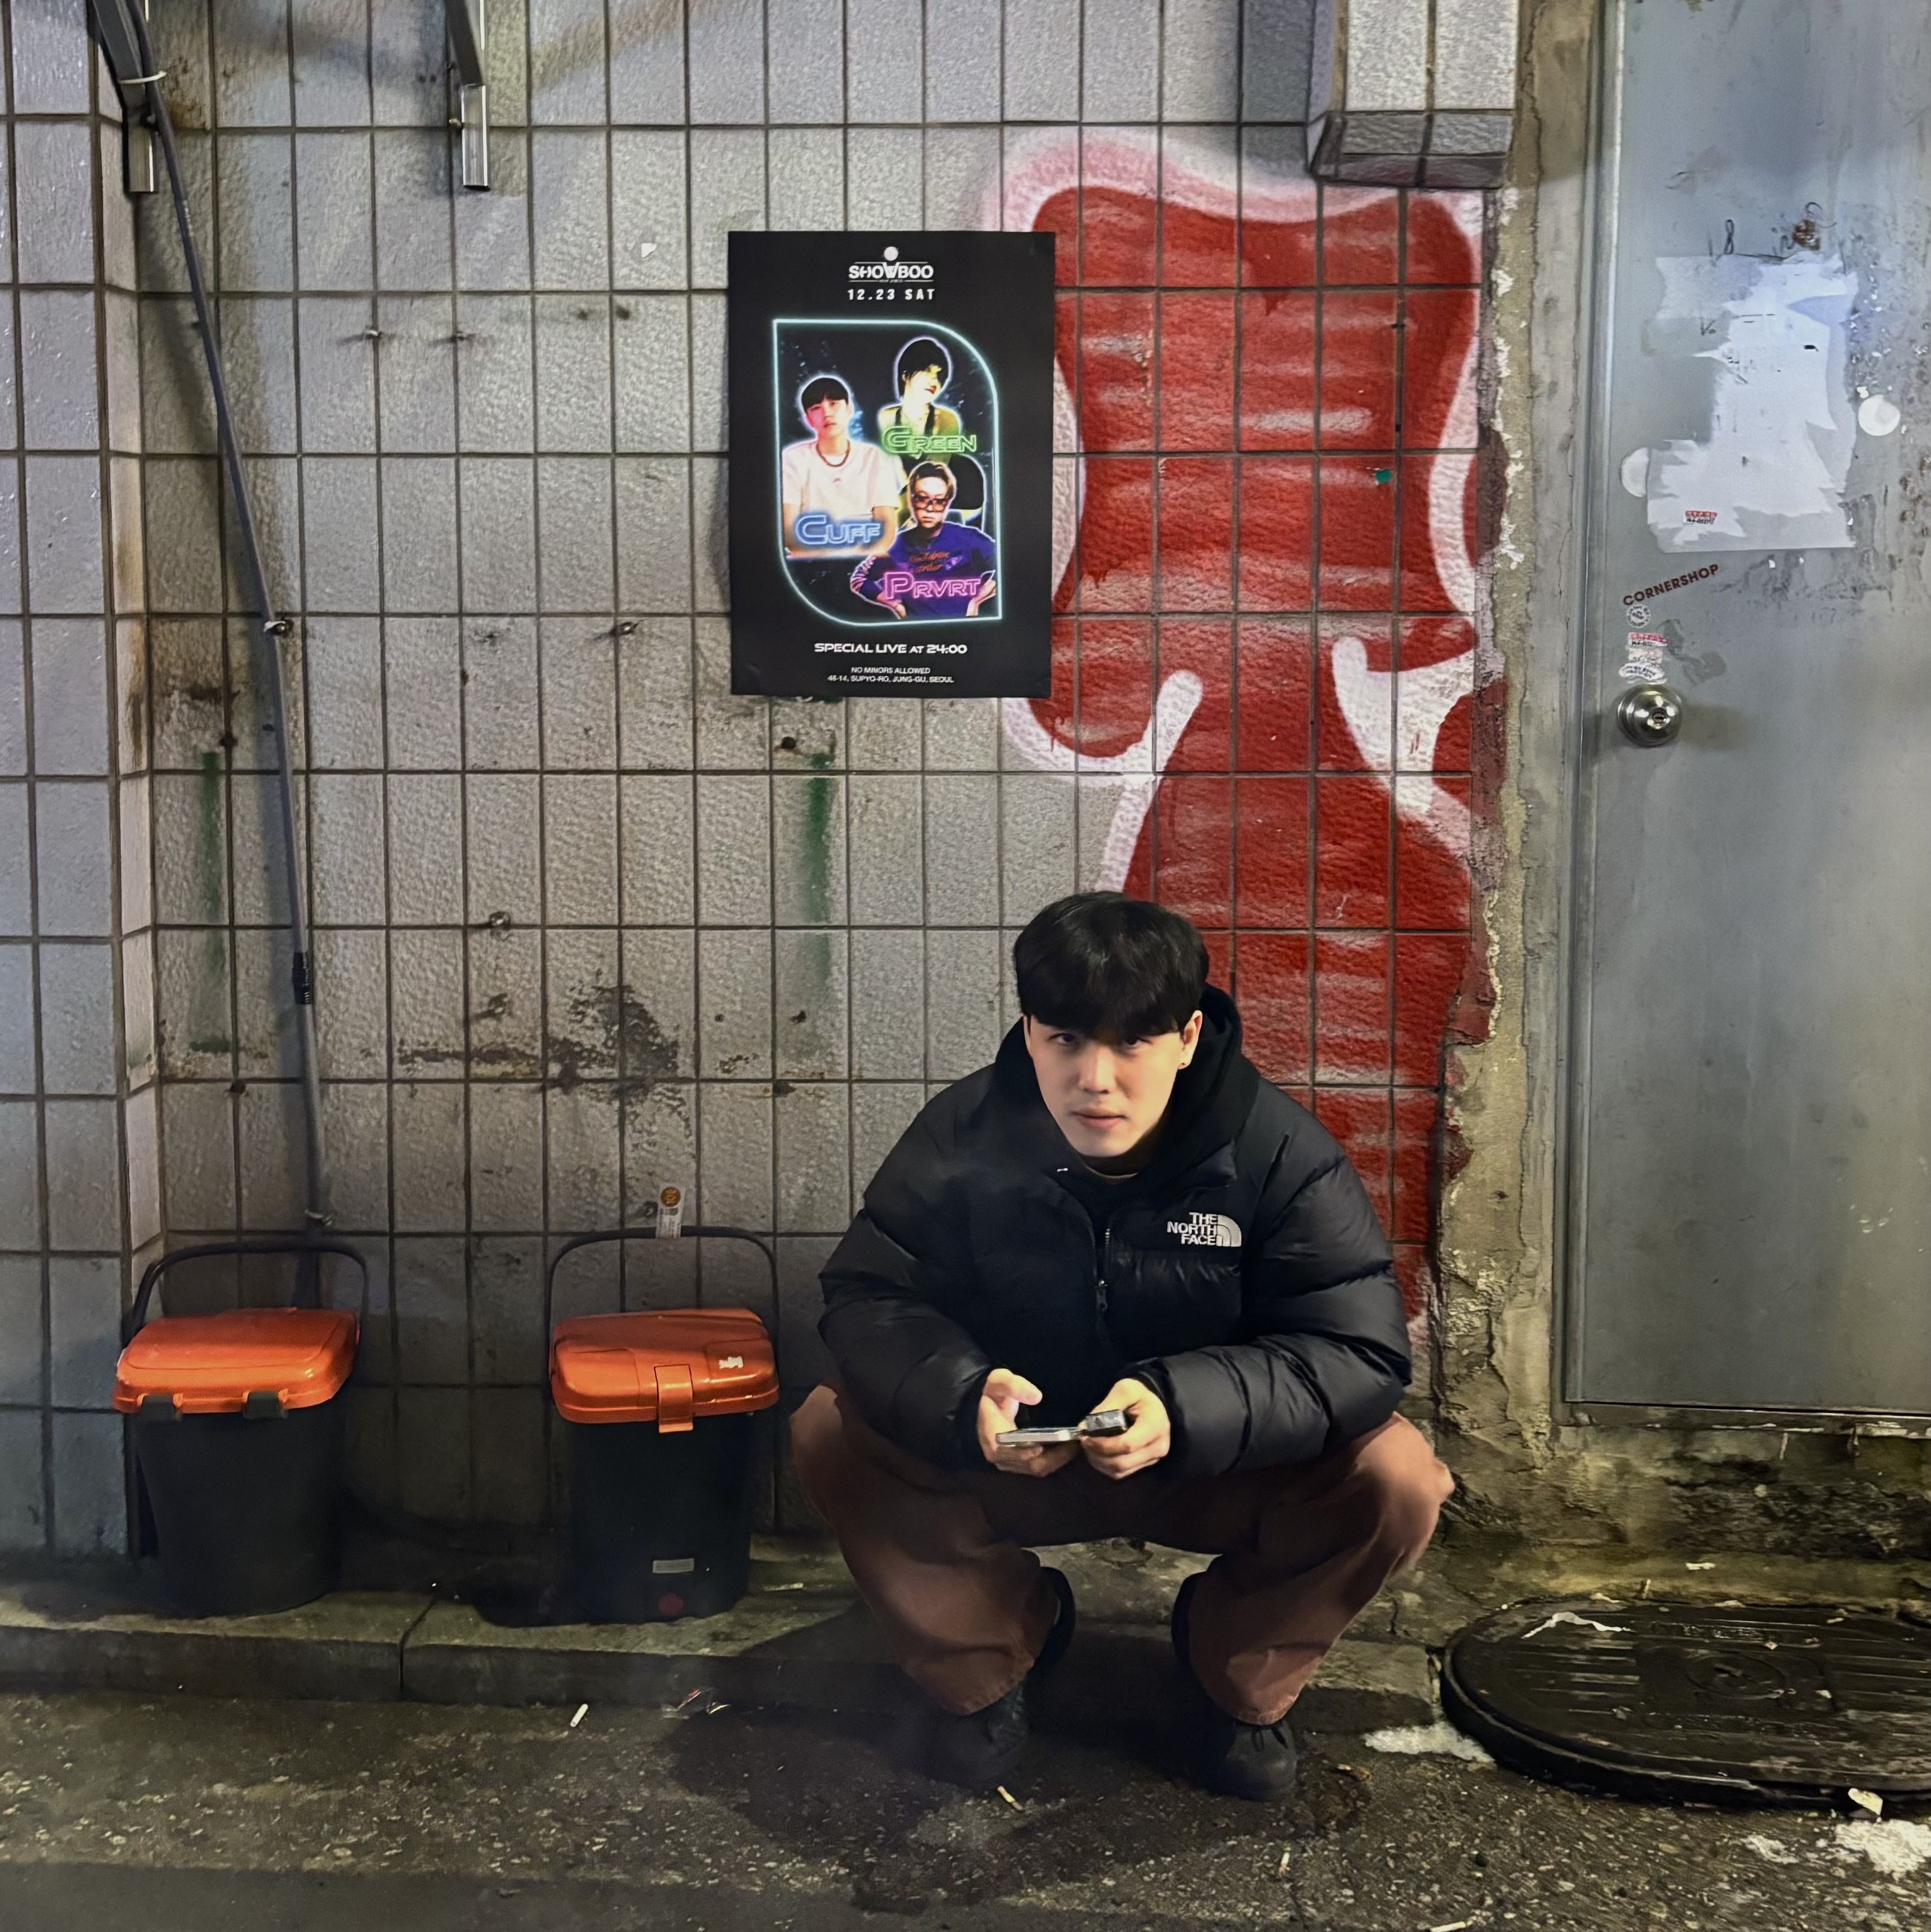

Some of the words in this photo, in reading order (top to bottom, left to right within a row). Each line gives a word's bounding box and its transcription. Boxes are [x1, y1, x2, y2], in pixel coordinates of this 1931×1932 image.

[848, 262, 934, 279] SHOWBOO
[848, 289, 895, 300] 12.23
[905, 289, 935, 300] SAT
[1623, 564, 1719, 605] CORNERSHOP
[814, 643, 874, 653] SPECIAL
[875, 644, 907, 653] LIVE
[926, 644, 968, 654] 24:00
[1189, 1212, 1218, 1224] THE
[1167, 1221, 1217, 1235] NORTH
[1181, 1233, 1216, 1246] FACE
